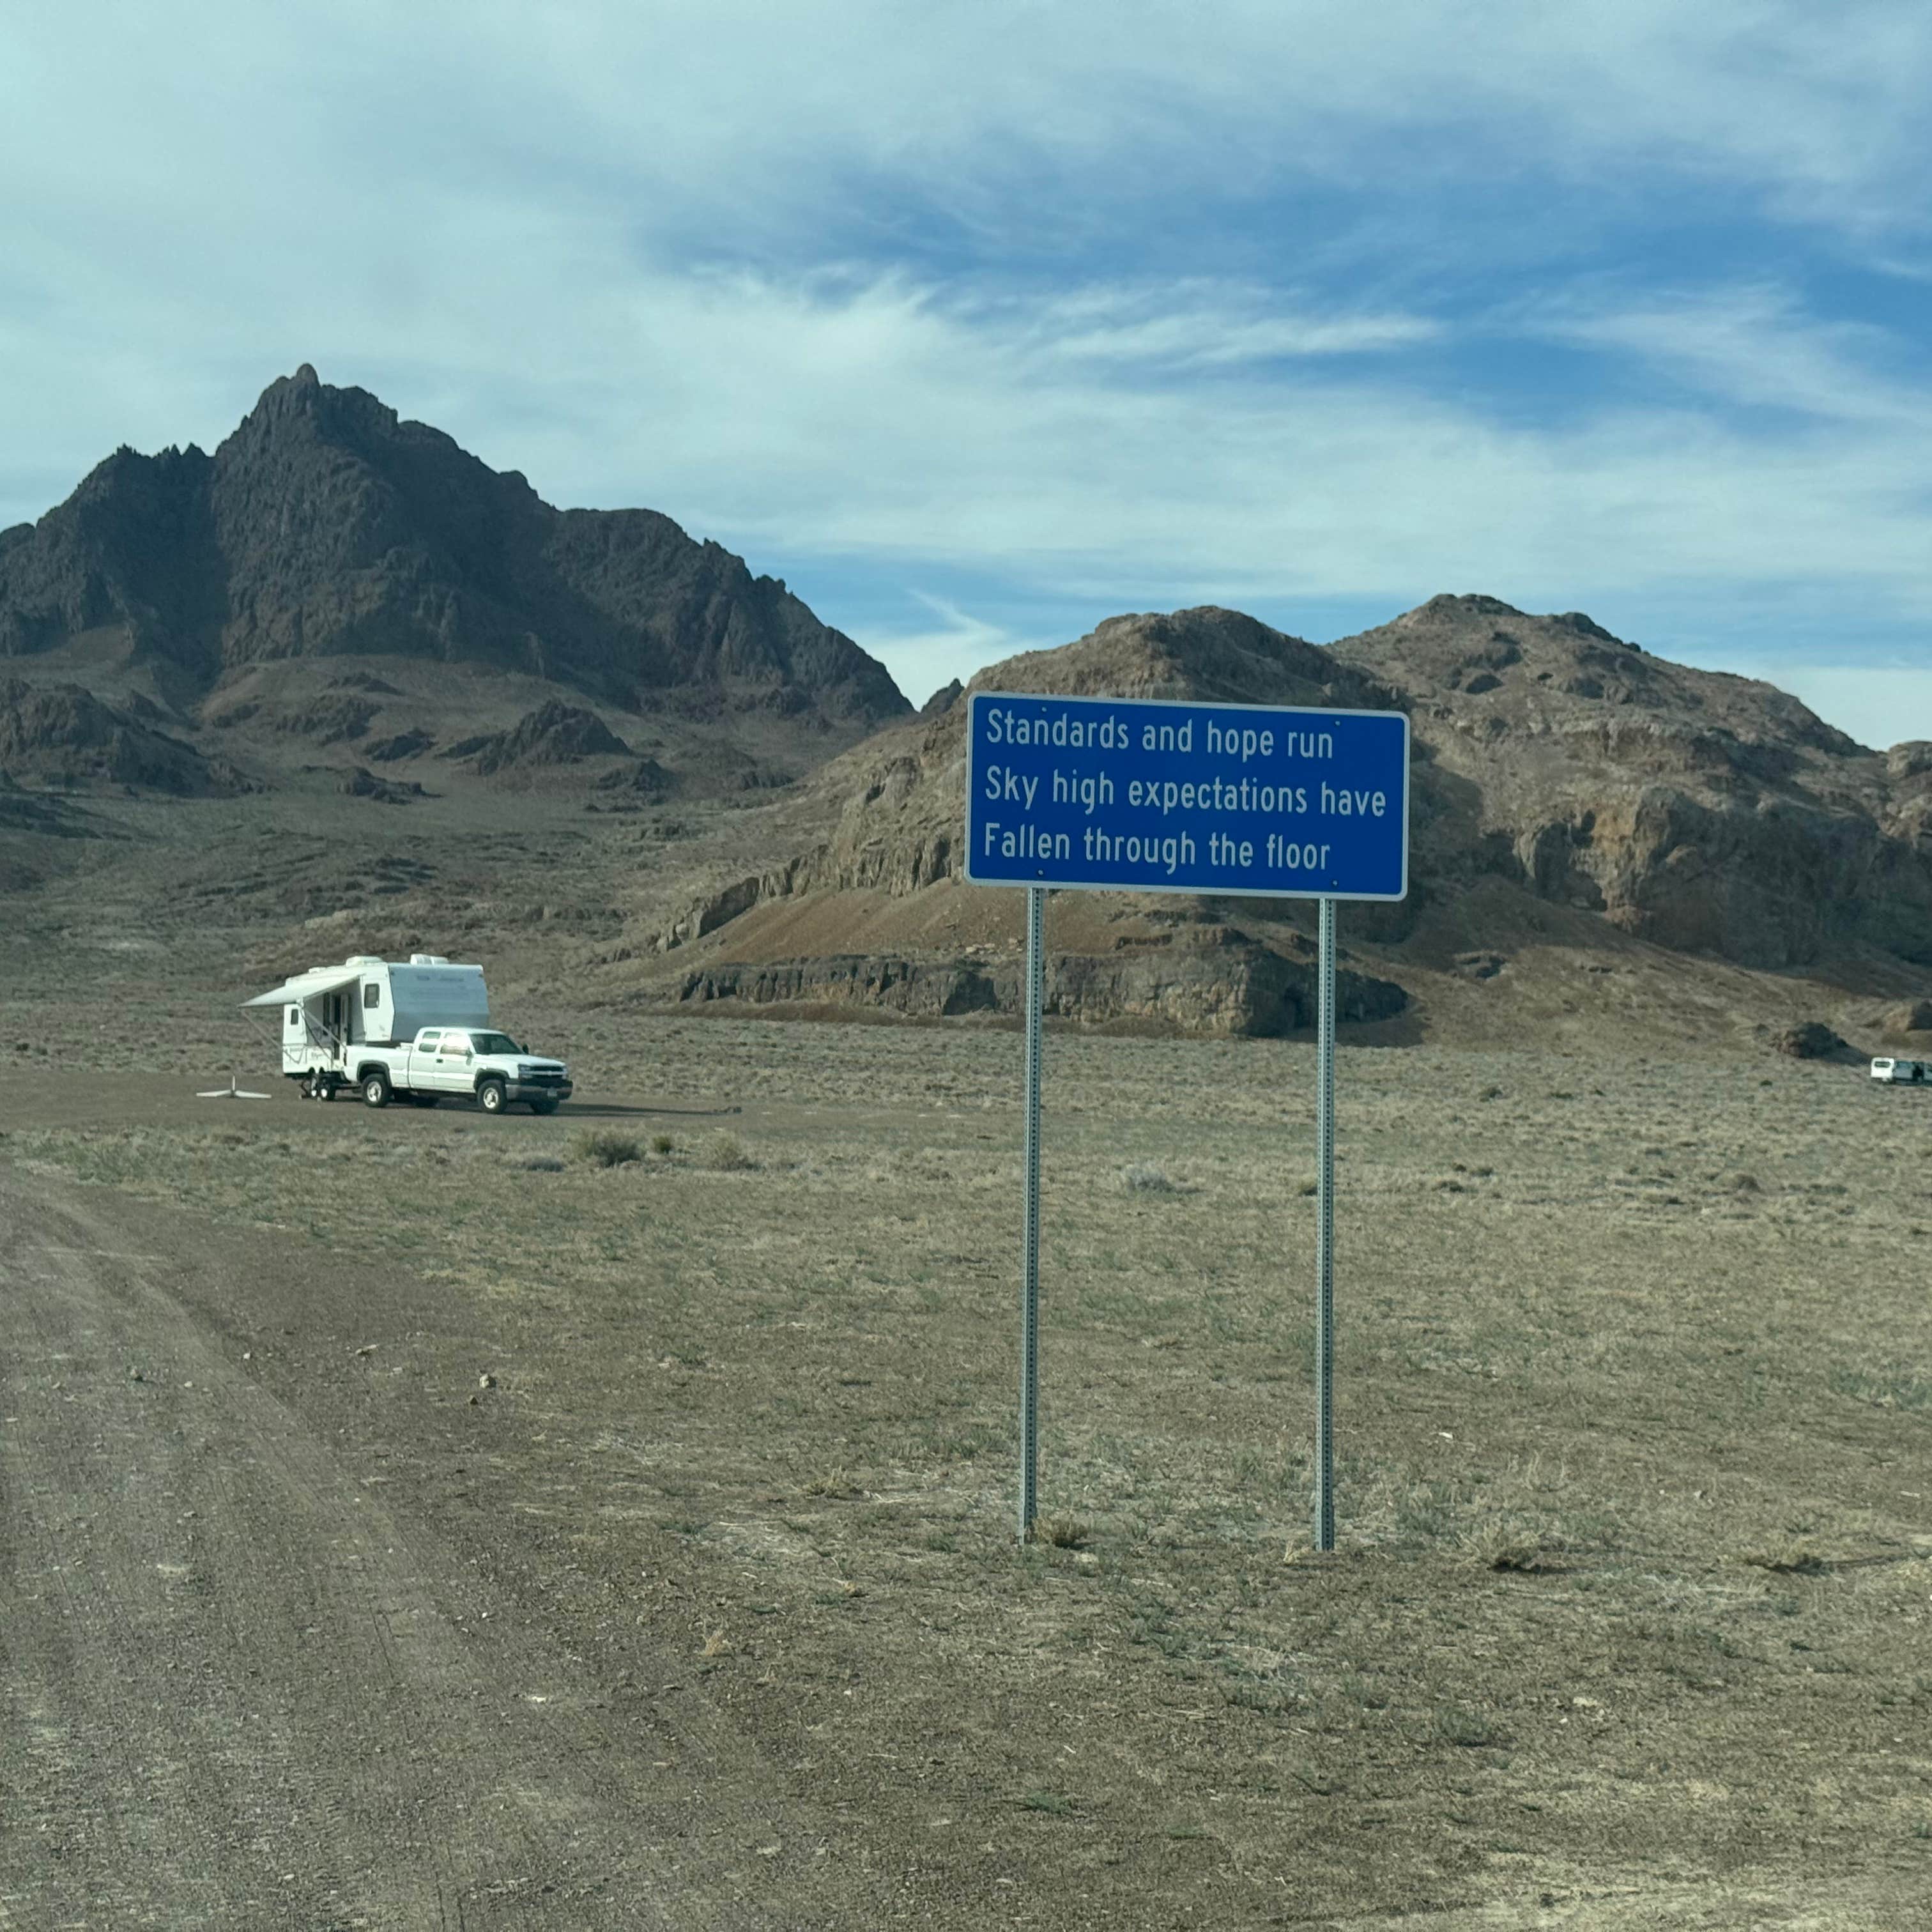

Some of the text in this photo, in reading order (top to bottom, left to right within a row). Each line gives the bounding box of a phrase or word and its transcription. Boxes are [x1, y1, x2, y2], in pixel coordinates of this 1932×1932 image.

[987, 709, 1332, 762] Standards and hope run
[986, 765, 1386, 816] Sky high expectations have
[985, 822, 1330, 875] Fallen through the floor
